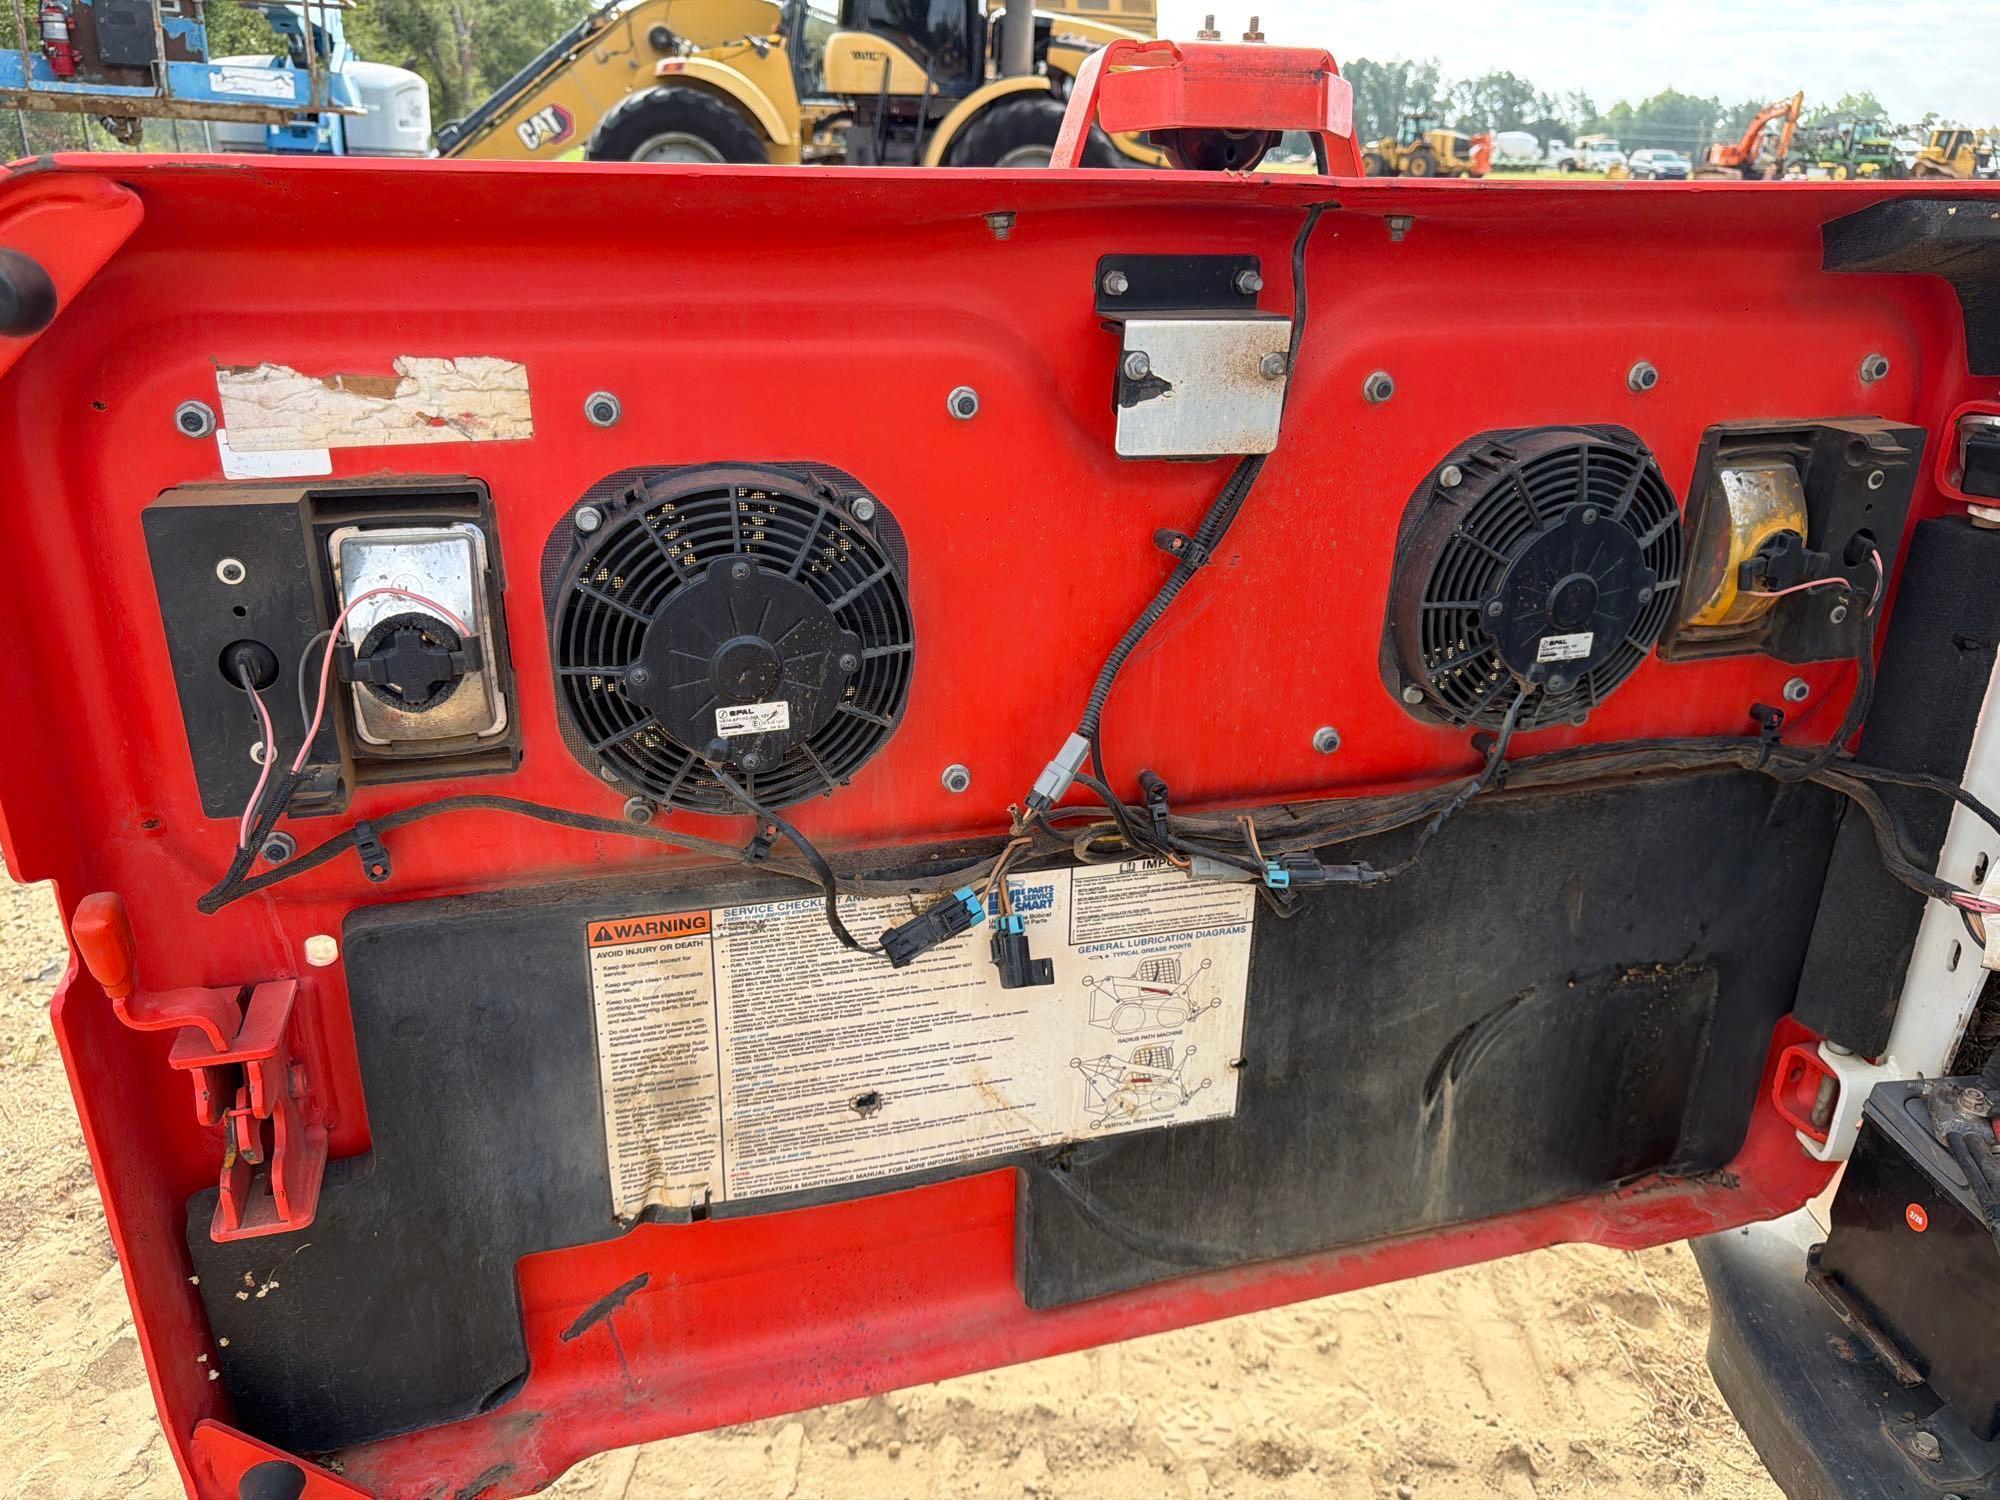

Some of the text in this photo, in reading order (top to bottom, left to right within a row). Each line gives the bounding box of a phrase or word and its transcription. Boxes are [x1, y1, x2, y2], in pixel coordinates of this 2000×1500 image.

[516, 106, 562, 150] CAT
[729, 708, 754, 716] SPAL
[1022, 892, 1053, 901] SERVICE
[1027, 885, 1054, 894] PARTS
[723, 904, 772, 918] SERVICE
[777, 895, 841, 911] CHECKLT
[1014, 898, 1053, 912] SMART
[613, 916, 706, 938] WARNING
[1077, 925, 1246, 954] GENERAL LUBRICATION DIAGRAMS
[596, 949, 623, 958] AVOID
[625, 945, 656, 954] INJURY
[674, 940, 703, 949] DEATH
[1112, 941, 1191, 958] TYPICAL GREASE POINTS
[1117, 1036, 1139, 1044] RADIUS
[1156, 1029, 1183, 1038] MACHINE
[1104, 1119, 1132, 1129] VERTICAL
[1148, 1112, 1174, 1122] MACHINE
[750, 1183, 791, 1196] OPERATION
[801, 1174, 853, 1187] MAINTENANCE
[856, 1168, 885, 1179] MANUAL
[888, 1165, 902, 1174] FOR
[904, 1161, 924, 1170] MORE
[927, 1152, 973, 1166] INFORMATION
[976, 1148, 989, 1157] AND
[992, 1139, 1041, 1154] INSTRUCTIONS
